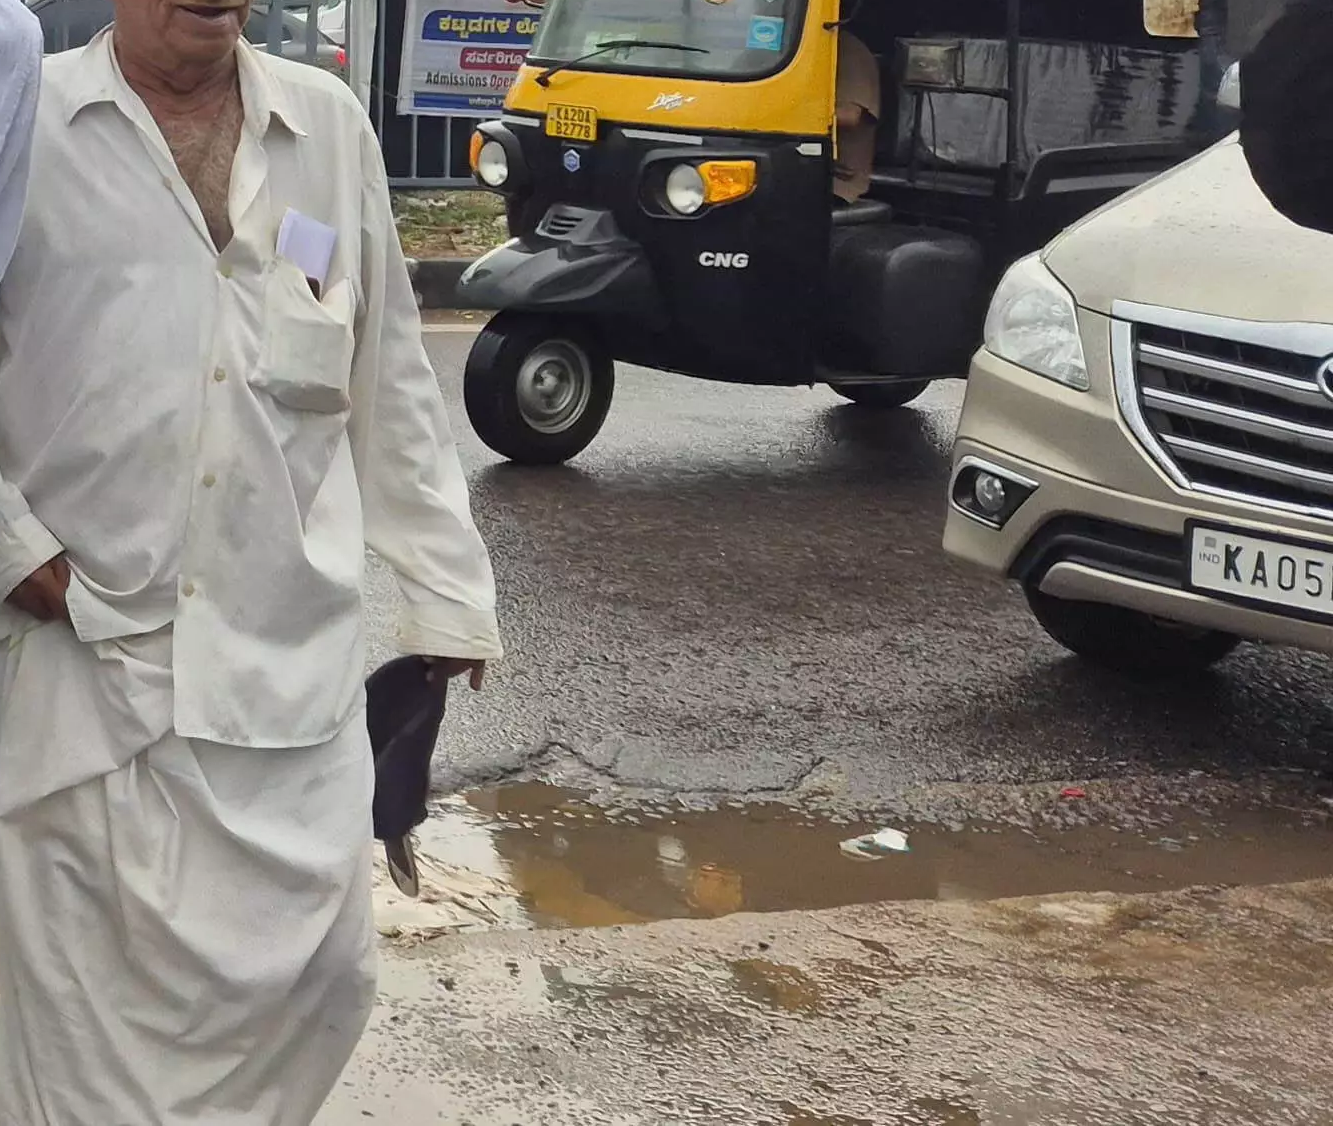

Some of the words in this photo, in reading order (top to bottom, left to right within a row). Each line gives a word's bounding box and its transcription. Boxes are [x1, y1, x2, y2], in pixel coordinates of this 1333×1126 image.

[425, 72, 488, 88] Admissions
[699, 251, 749, 268] CNG
[1199, 551, 1220, 564] IND
[1224, 543, 1333, 602] KA05
